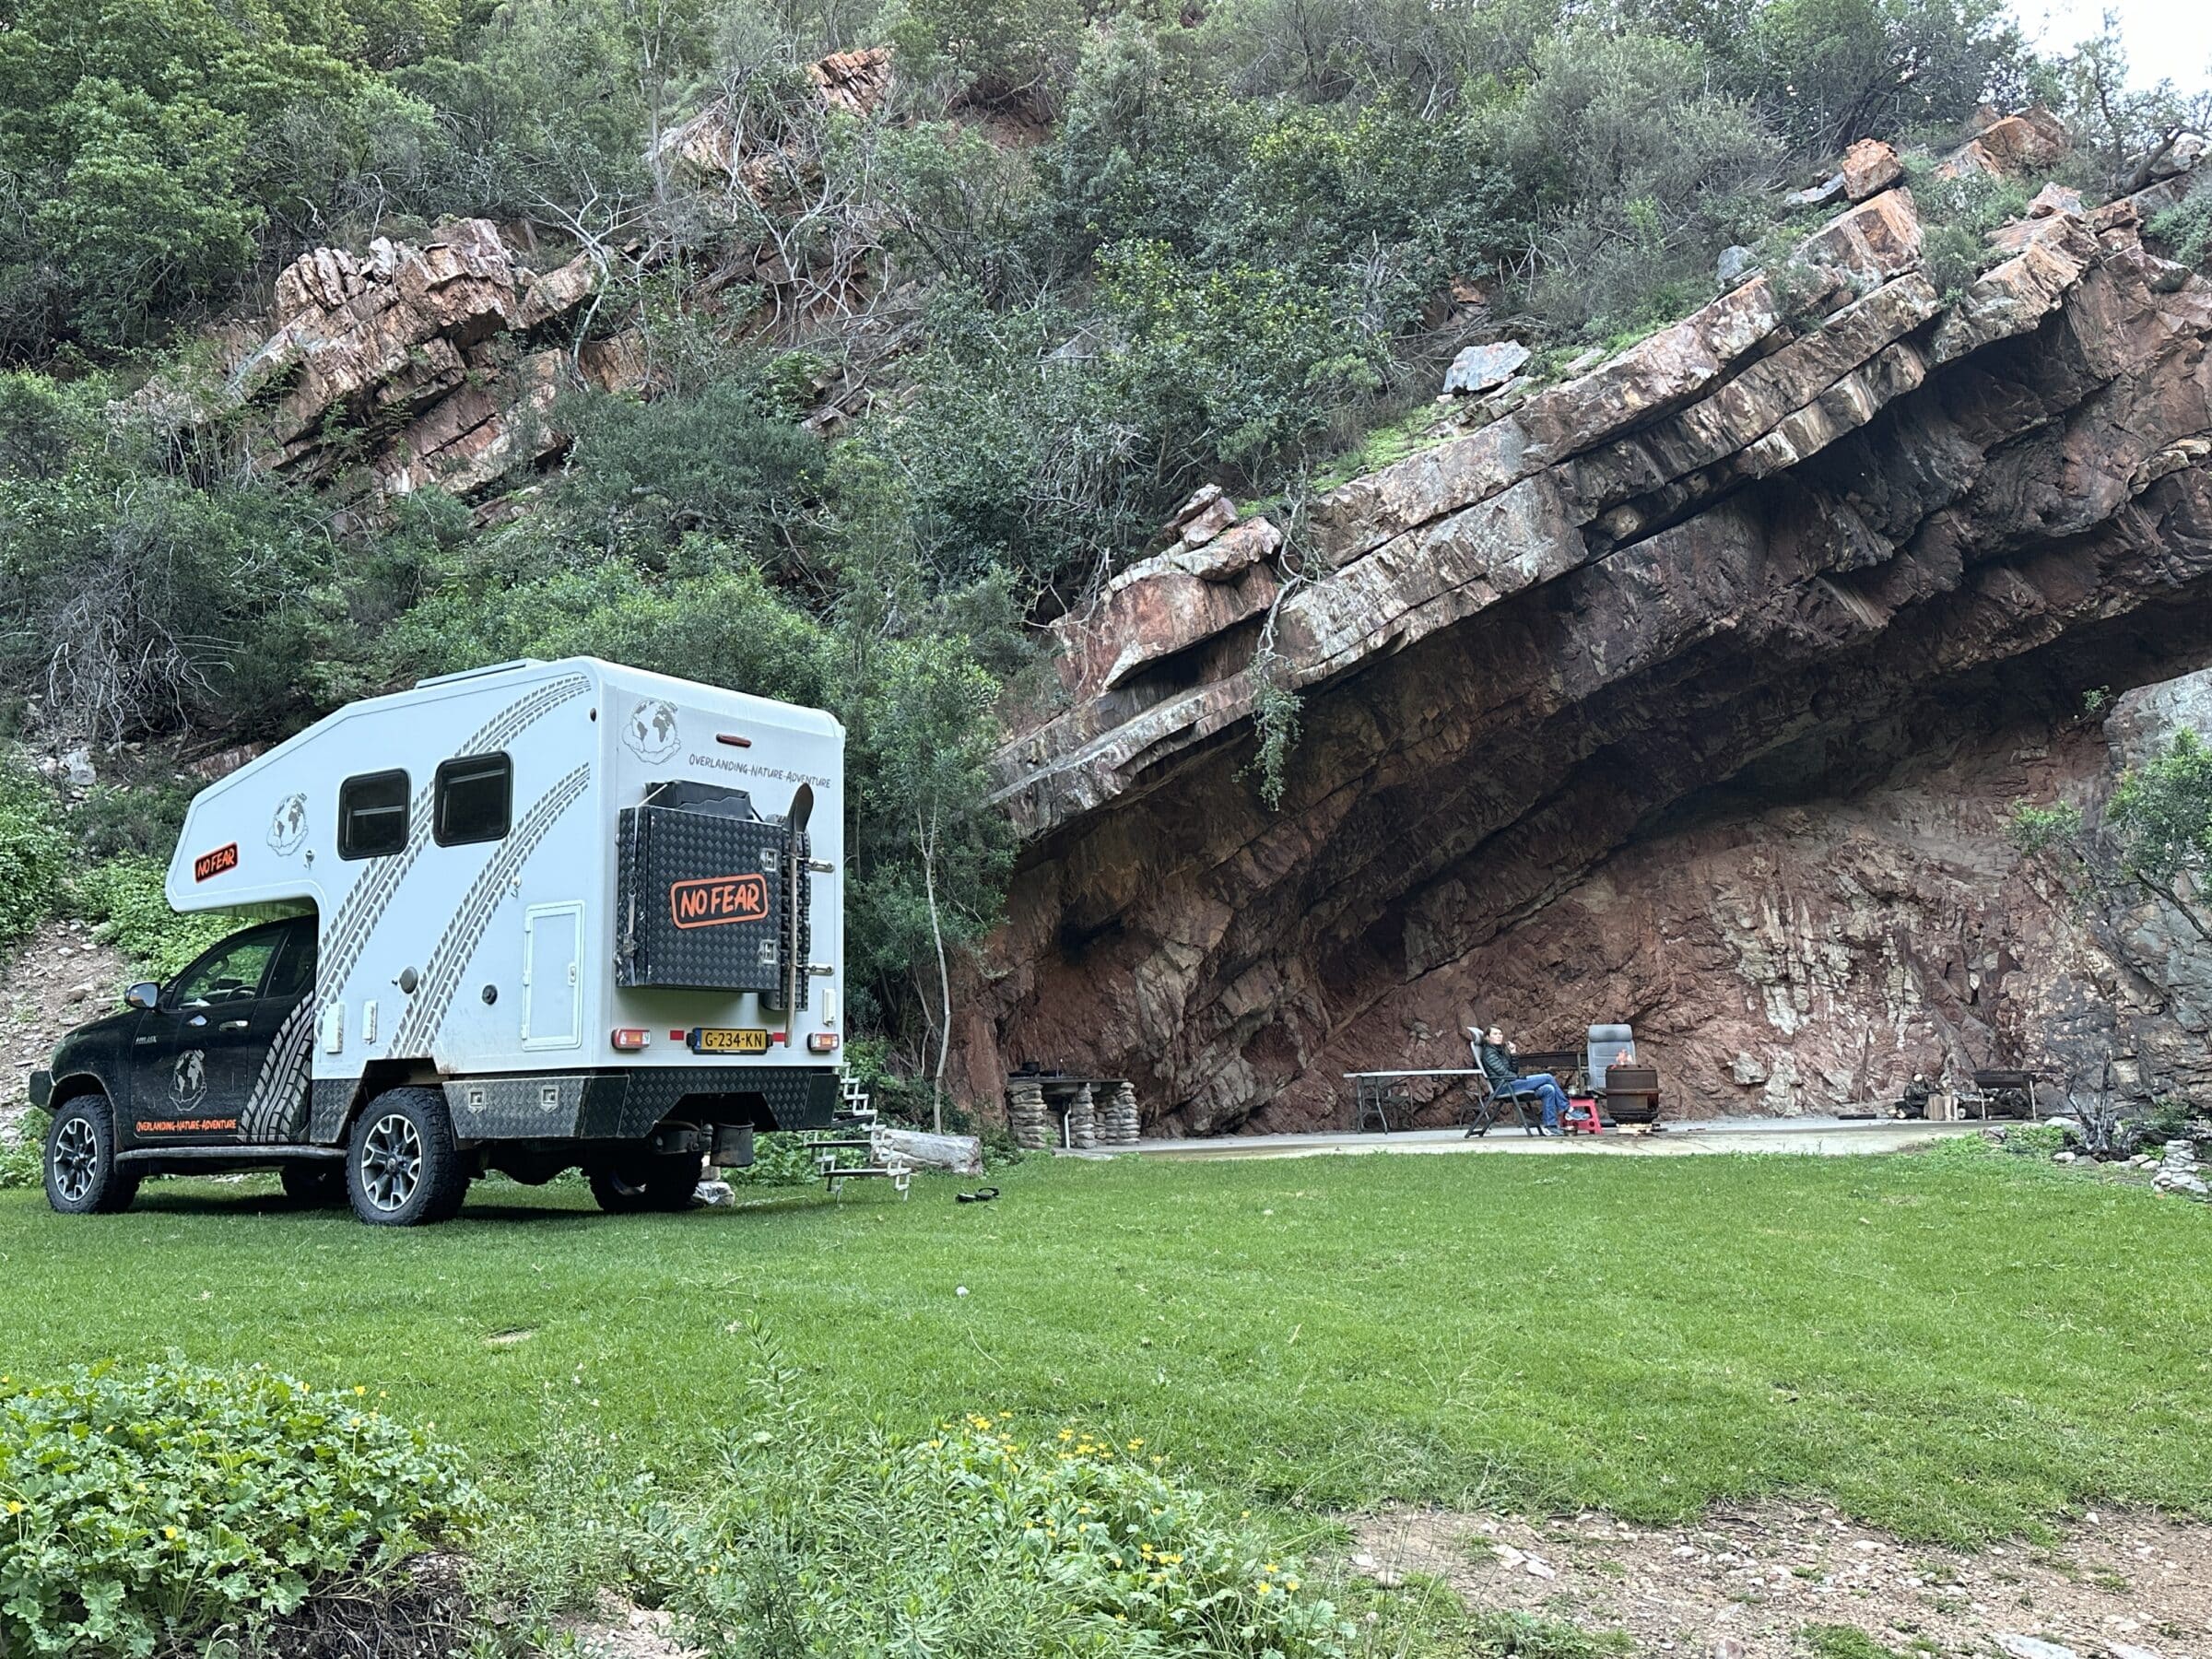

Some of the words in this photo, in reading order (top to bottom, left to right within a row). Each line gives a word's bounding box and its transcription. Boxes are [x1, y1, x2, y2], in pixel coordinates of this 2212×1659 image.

[197, 858, 210, 877] NO
[211, 848, 234, 872] FEAR
[680, 888, 707, 918] NO
[711, 882, 760, 914] FEAR
[705, 1032, 762, 1047] G-234-KN
